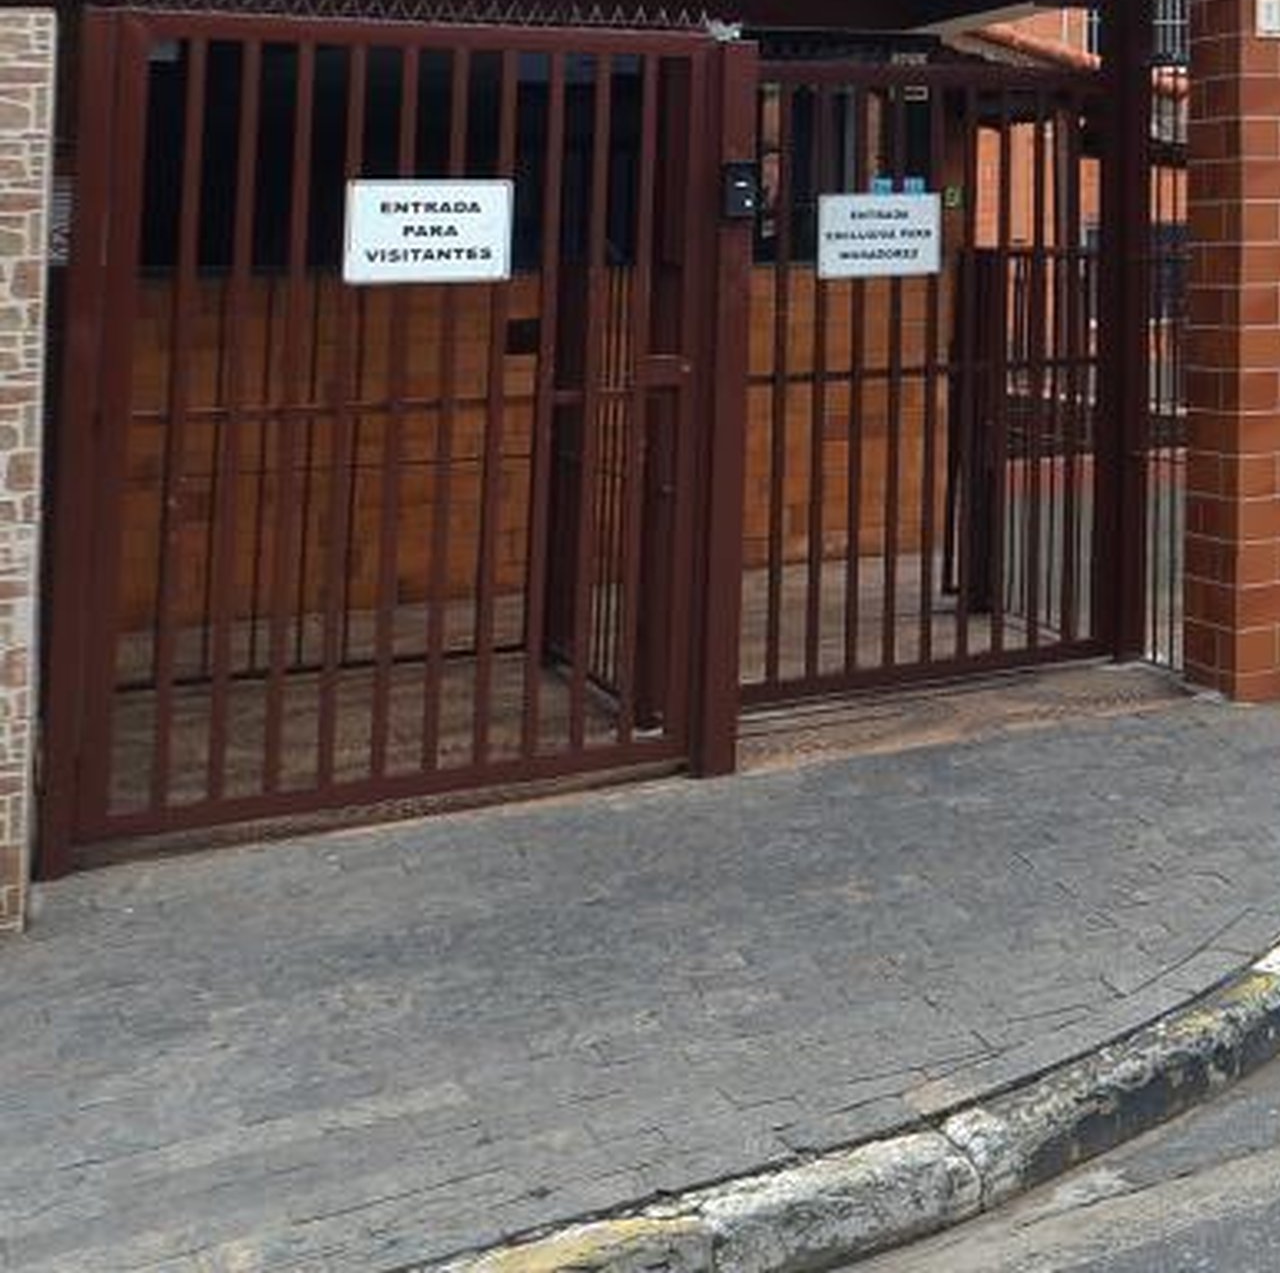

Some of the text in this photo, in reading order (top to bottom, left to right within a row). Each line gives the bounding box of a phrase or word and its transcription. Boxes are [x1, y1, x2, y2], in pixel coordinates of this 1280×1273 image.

[380, 201, 482, 214] ENTRADA
[402, 225, 459, 237] PARA
[365, 247, 492, 262] VISITANTES
